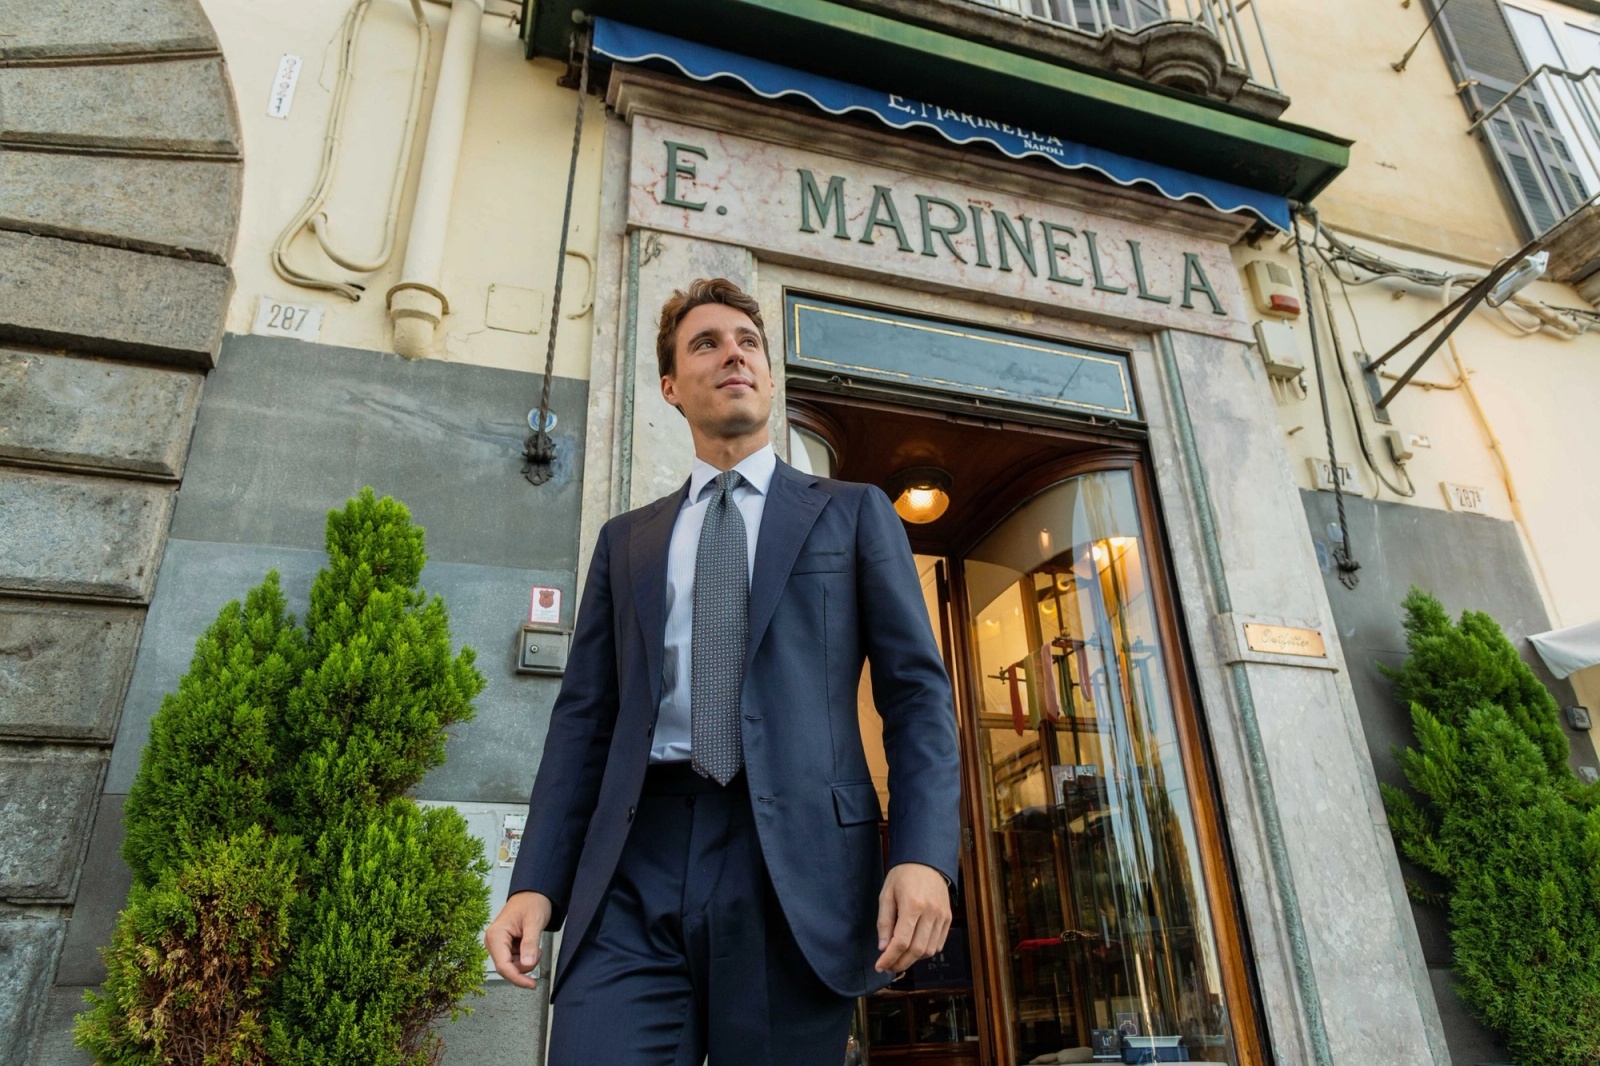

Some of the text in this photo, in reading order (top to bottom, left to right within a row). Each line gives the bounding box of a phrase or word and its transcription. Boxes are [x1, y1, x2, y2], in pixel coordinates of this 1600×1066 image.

[1023, 139, 1065, 156] NAPOLI
[660, 140, 1228, 315] E. MARINELLA
[267, 304, 310, 331] 287
